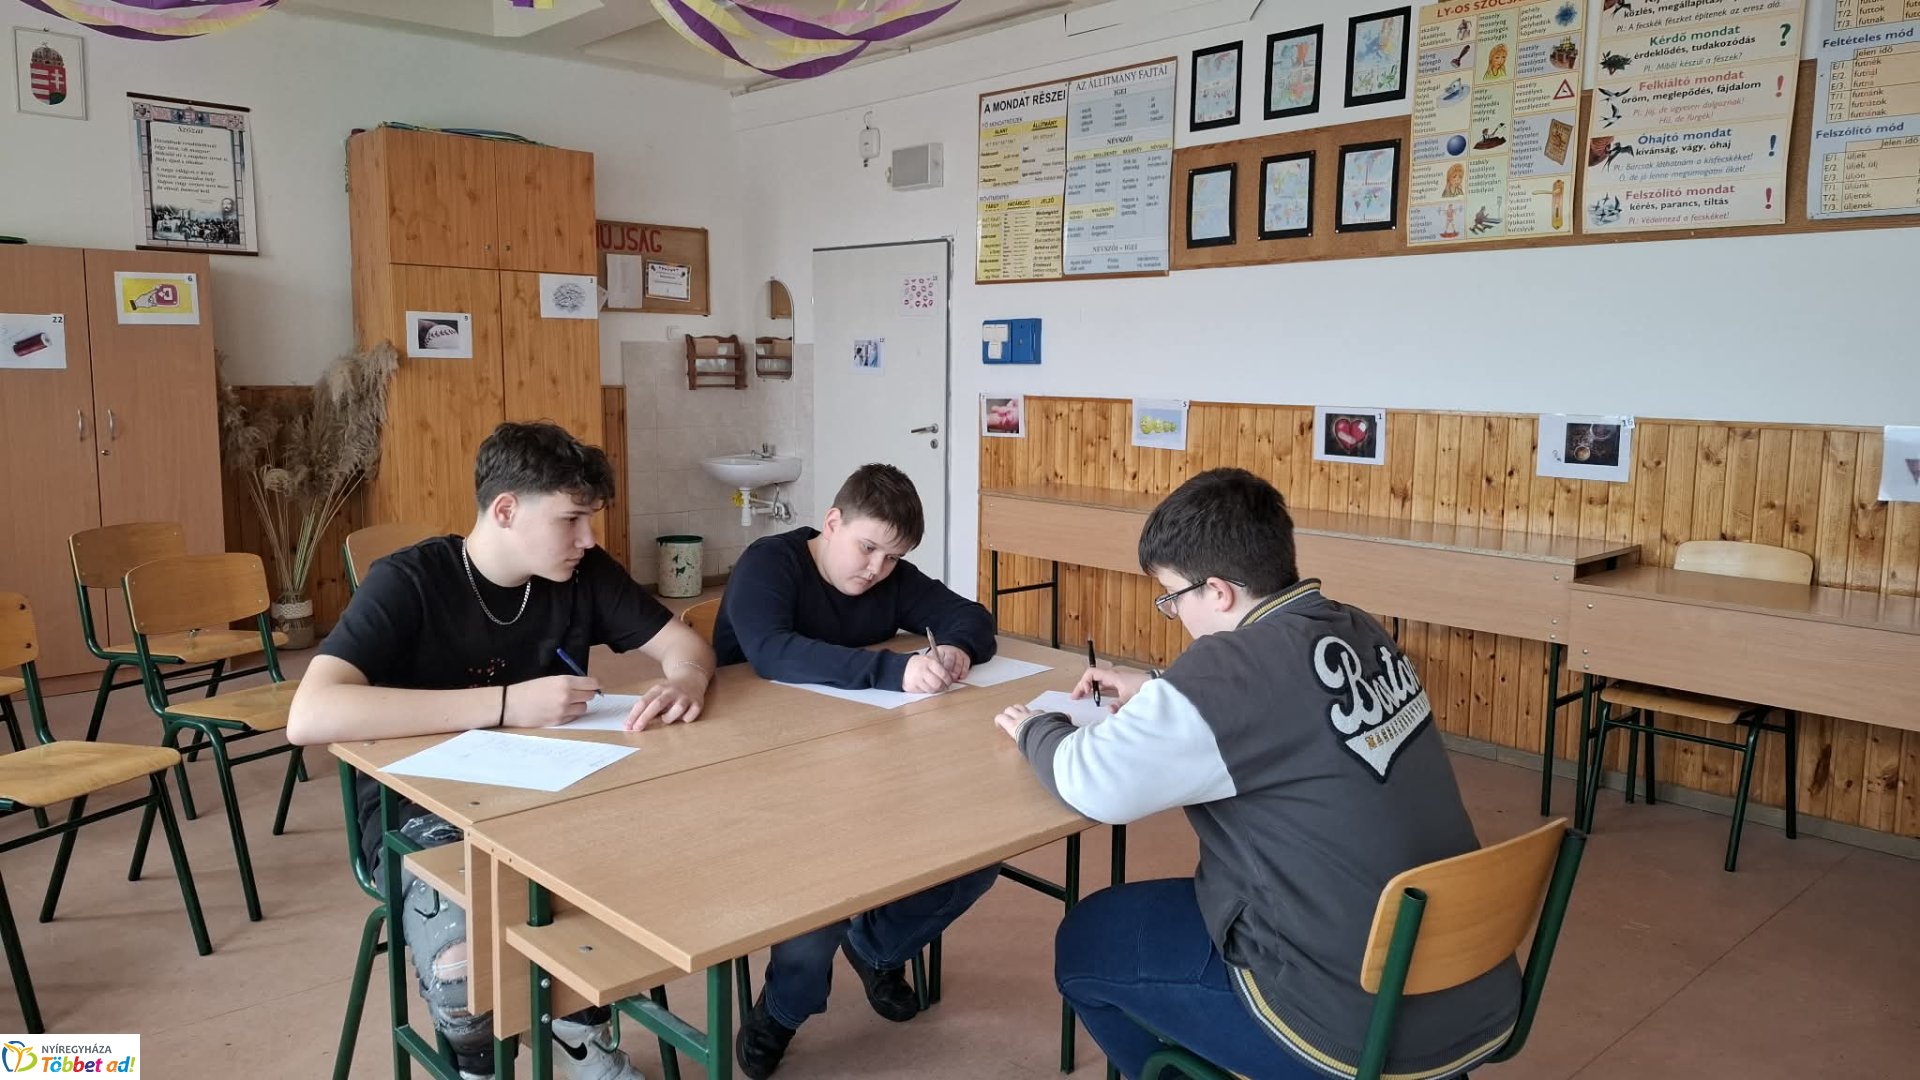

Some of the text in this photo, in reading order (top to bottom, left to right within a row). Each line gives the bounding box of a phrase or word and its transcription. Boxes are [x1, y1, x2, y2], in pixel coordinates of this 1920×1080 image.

[1437, 2, 1470, 18] LY-OS
[1624, 8, 1655, 18] közlés,
[1665, 15, 1692, 26] fészket
[1695, 9, 1727, 21] építenek
[1859, 16, 1884, 25] futnak
[1650, 25, 1740, 46] Kérdő mondat
[1823, 28, 1914, 48] Feltételes mód
[1634, 36, 1755, 60] érdeklődés, tudakozódás
[1076, 82, 1086, 90] AZ
[1639, 70, 1744, 91] Felkiáltó mondat
[1114, 88, 1126, 96] IGEI
[1621, 81, 1761, 104] öröm, meglepődés, fájdalom
[984, 90, 1065, 114] A MONDAT RÉSZEI
[1638, 128, 1733, 147] Óhajtó mondat
[1816, 122, 1904, 139] Felszólító mód
[1636, 140, 1731, 156] kívánság, vágy, óhaj
[1626, 184, 1735, 200] Felszólító mondat
[1629, 197, 1729, 211] kérés, parancs, tiltás
